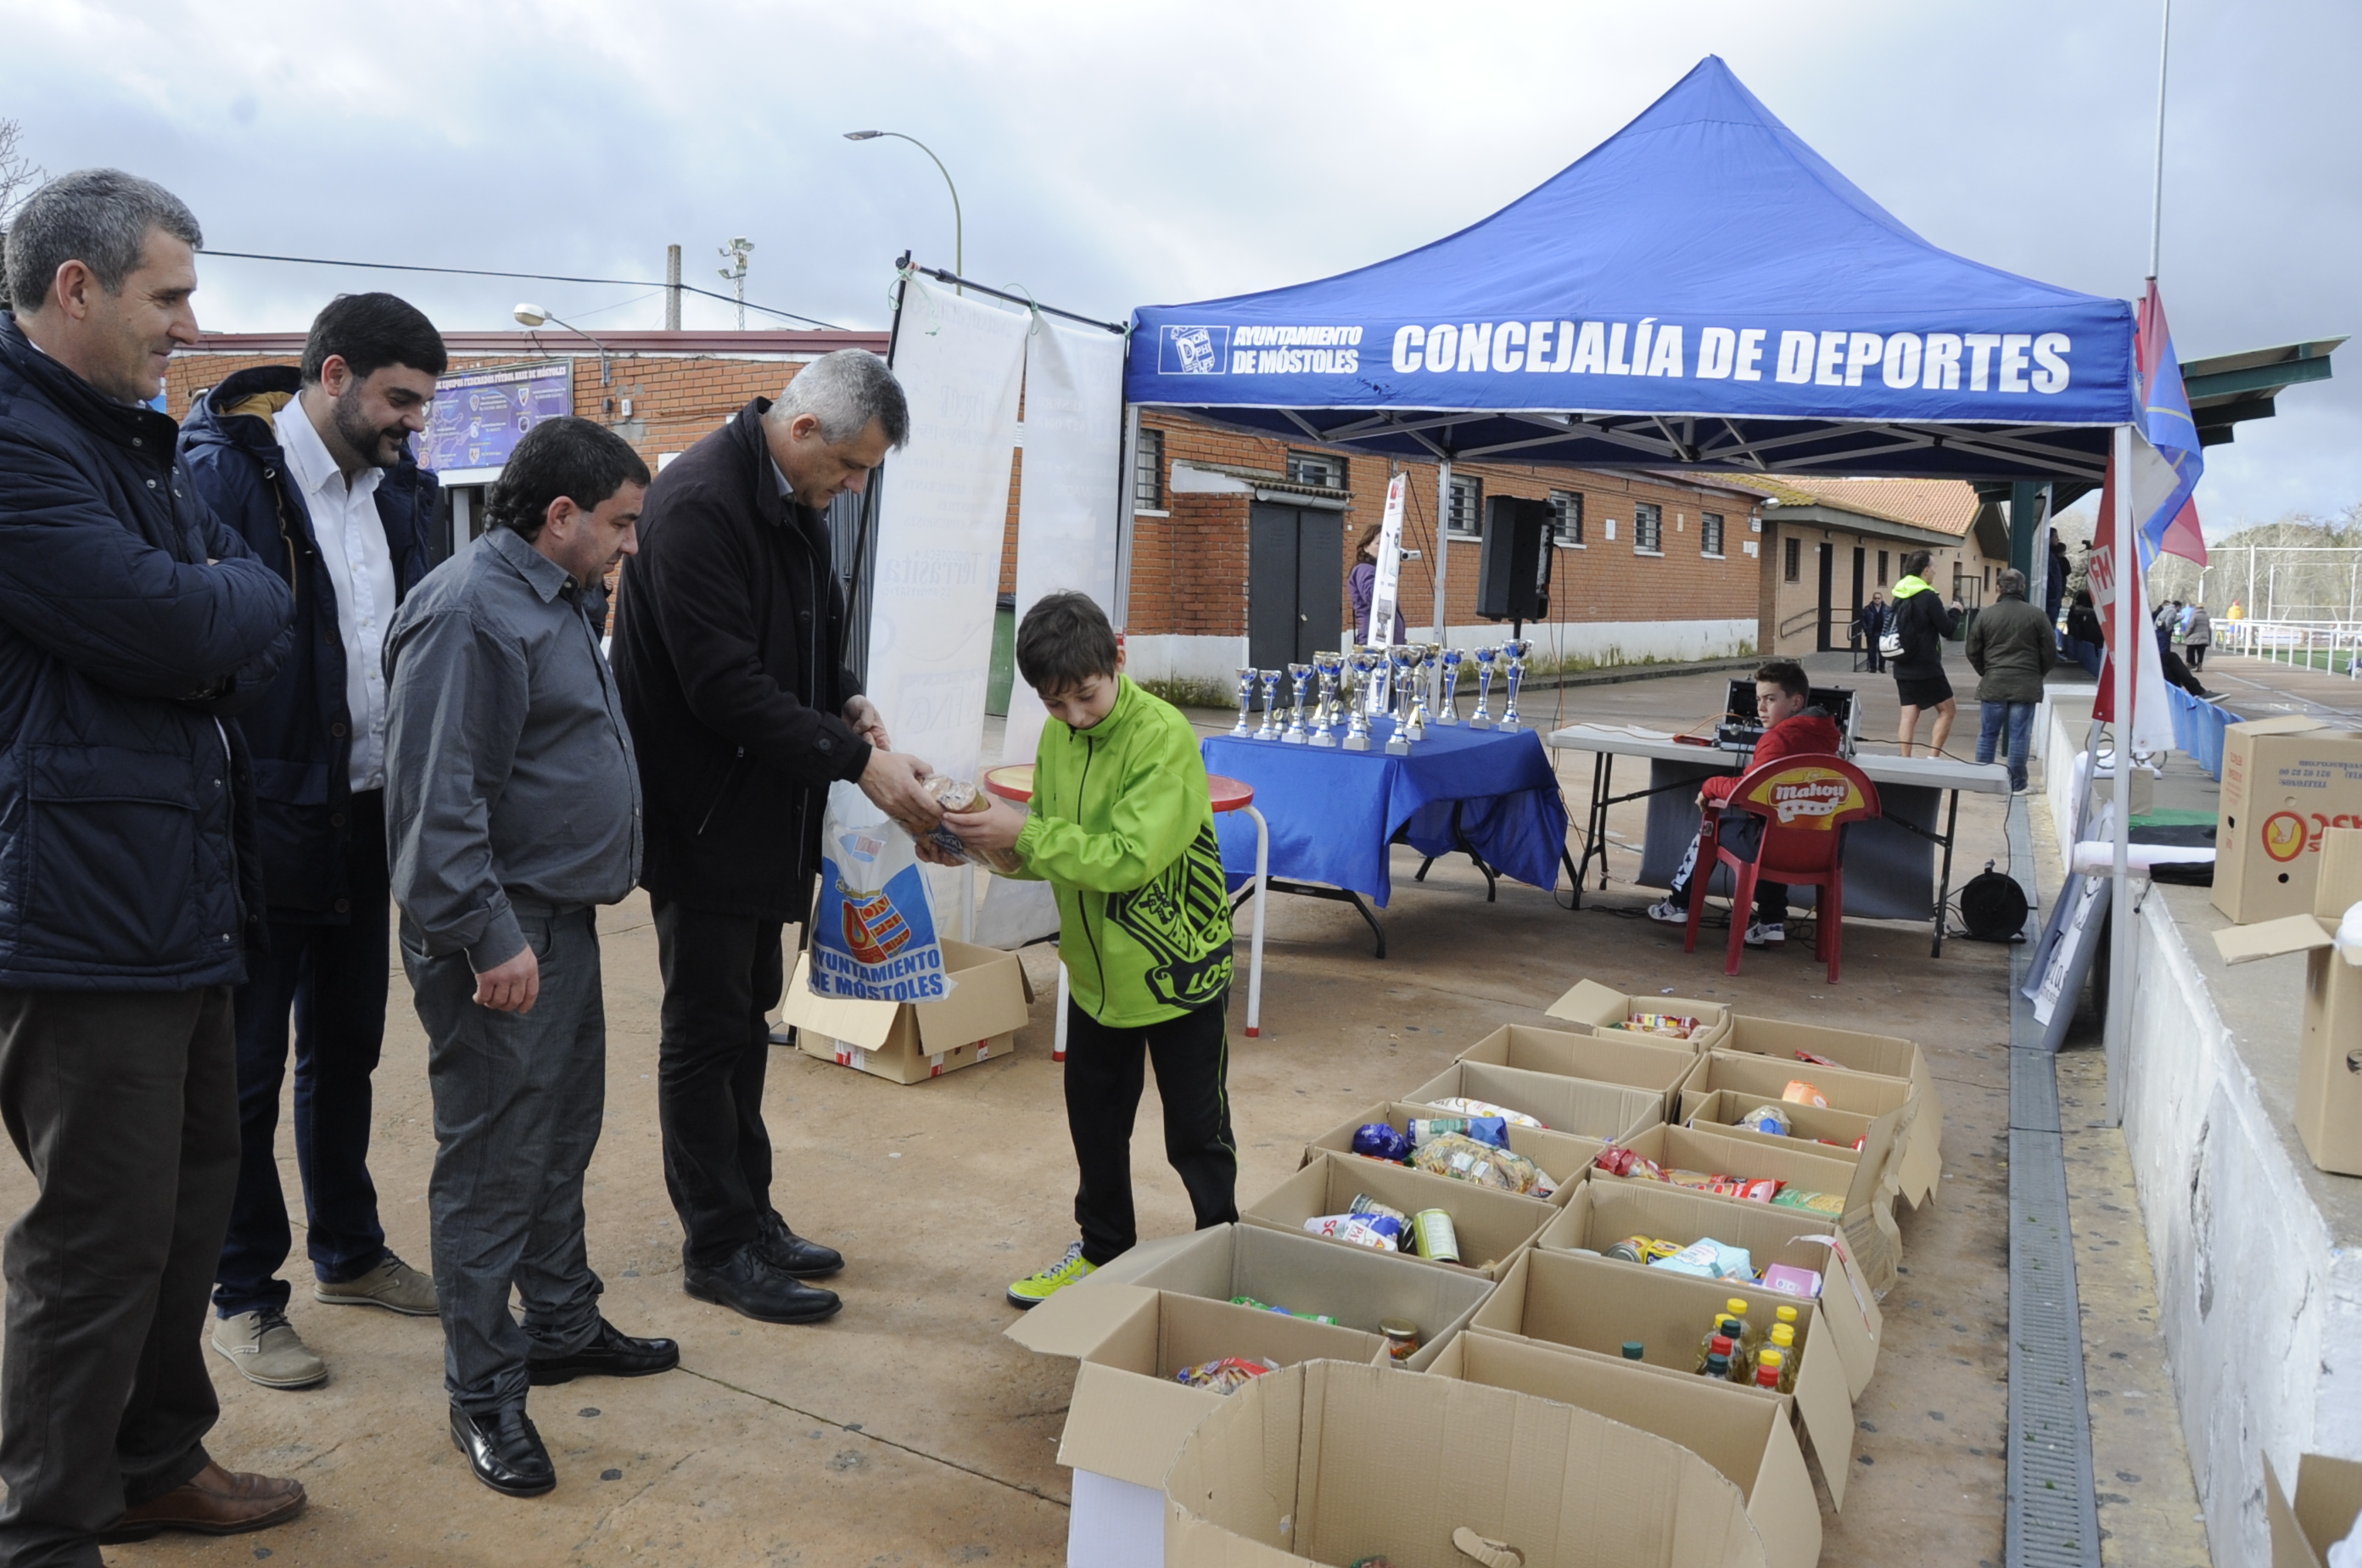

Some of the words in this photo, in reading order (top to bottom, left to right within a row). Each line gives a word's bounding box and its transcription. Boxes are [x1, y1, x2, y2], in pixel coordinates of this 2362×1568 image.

[1232, 325, 1363, 346] AYUNTAMIENTO
[1232, 350, 1260, 374] DE
[1262, 345, 1359, 374] MÓSTOLES
[1392, 317, 1683, 378] CONCEJALÍA
[1696, 327, 1767, 380] DE
[1775, 329, 2071, 394] DEPORTES
[1776, 782, 1845, 800] Mahou
[812, 949, 941, 983] AYUNTAMIENTO
[810, 972, 830, 993] DE
[836, 973, 943, 1001] MÓSTOLES
